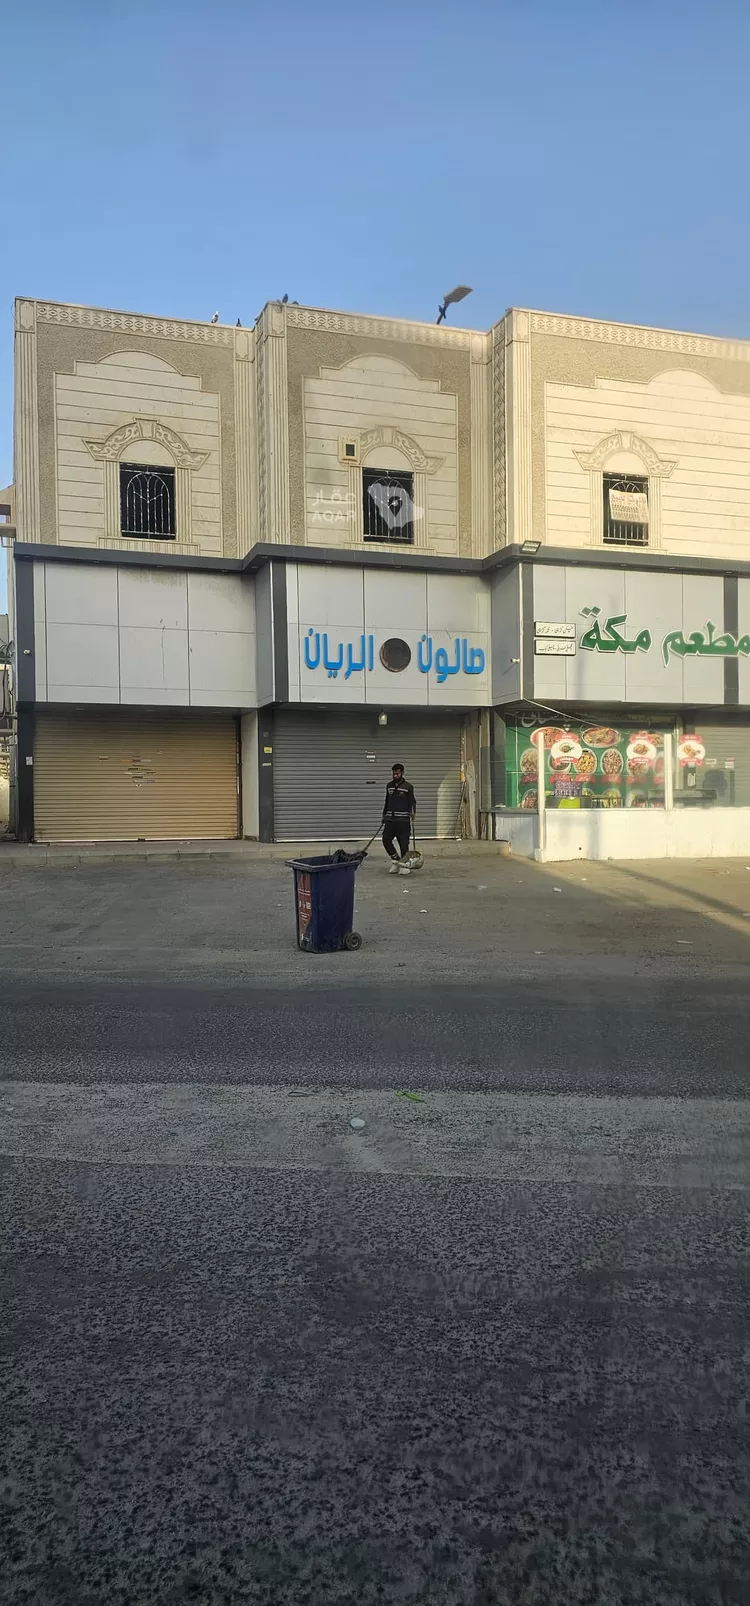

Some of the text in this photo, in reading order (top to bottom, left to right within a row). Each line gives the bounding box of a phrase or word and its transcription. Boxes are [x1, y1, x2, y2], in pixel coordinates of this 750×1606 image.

[304, 628, 486, 683] صالون الريان
[579, 606, 750, 668] مطعم مكة
